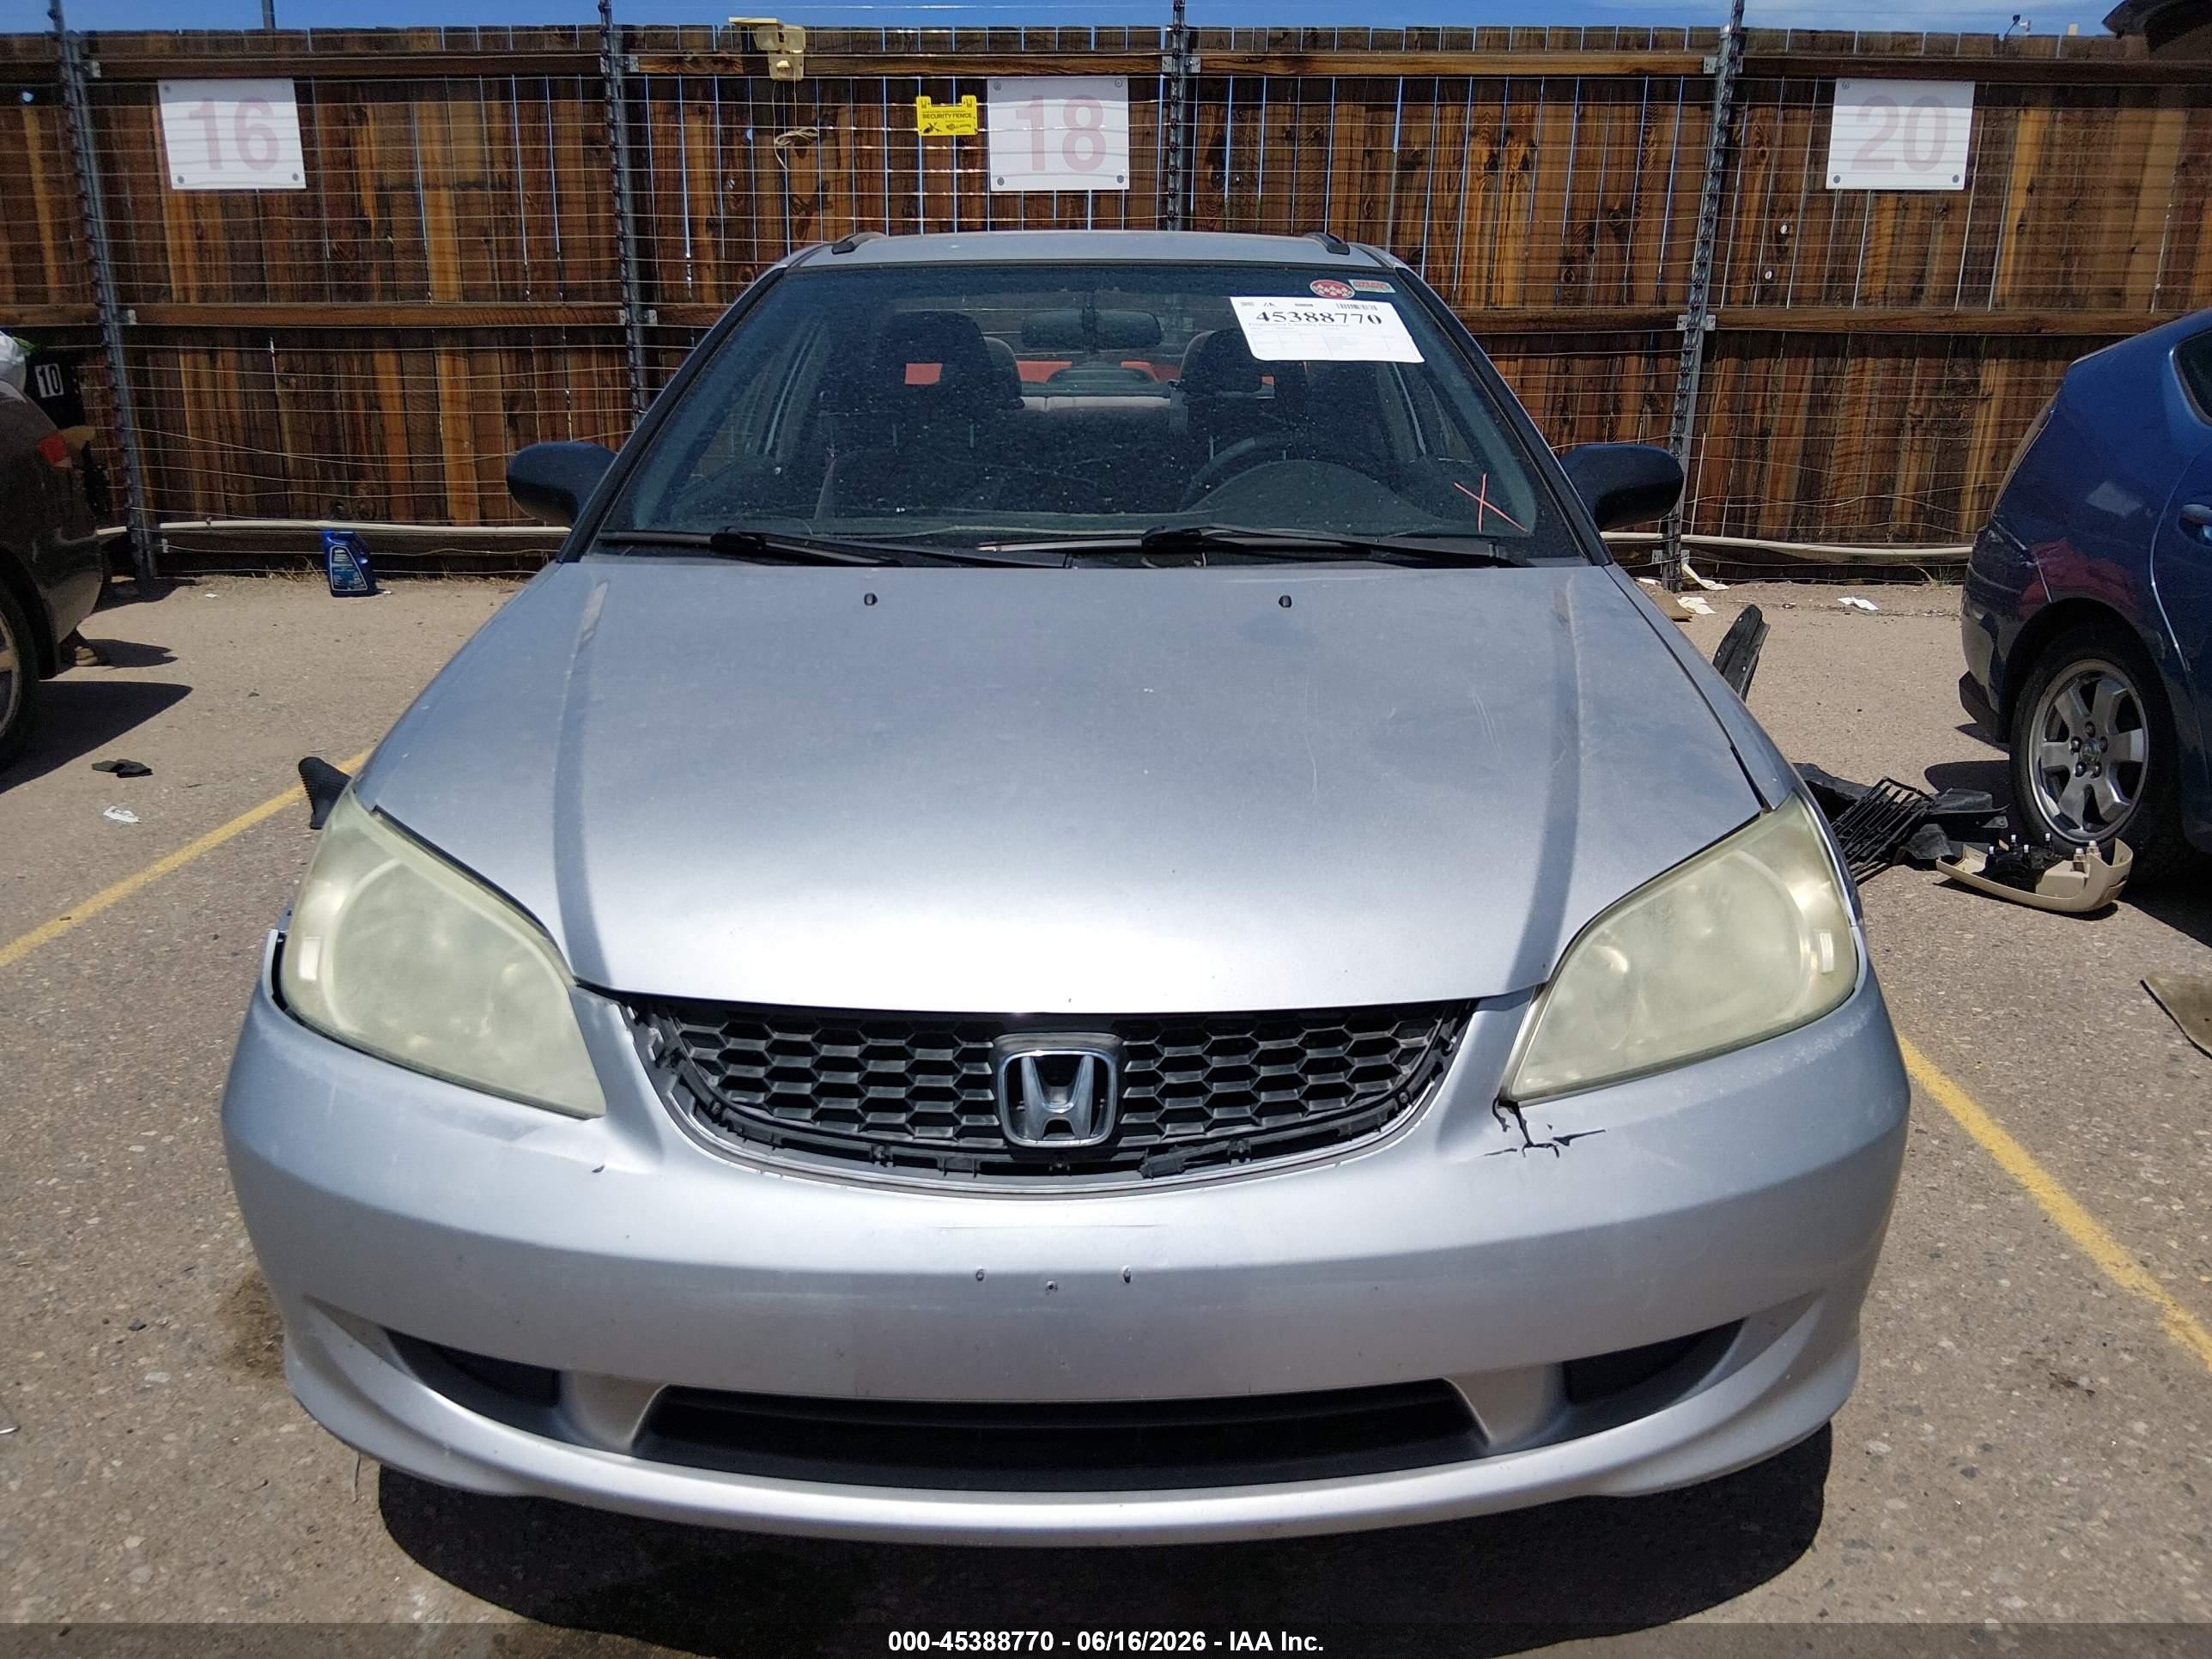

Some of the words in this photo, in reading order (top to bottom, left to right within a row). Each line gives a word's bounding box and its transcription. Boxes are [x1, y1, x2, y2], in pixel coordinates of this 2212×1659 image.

[188, 95, 280, 172] 16
[1015, 94, 1107, 172] 18
[1850, 94, 1948, 172] 20
[1255, 310, 1382, 325] 45388770
[39, 365, 62, 396] 10
